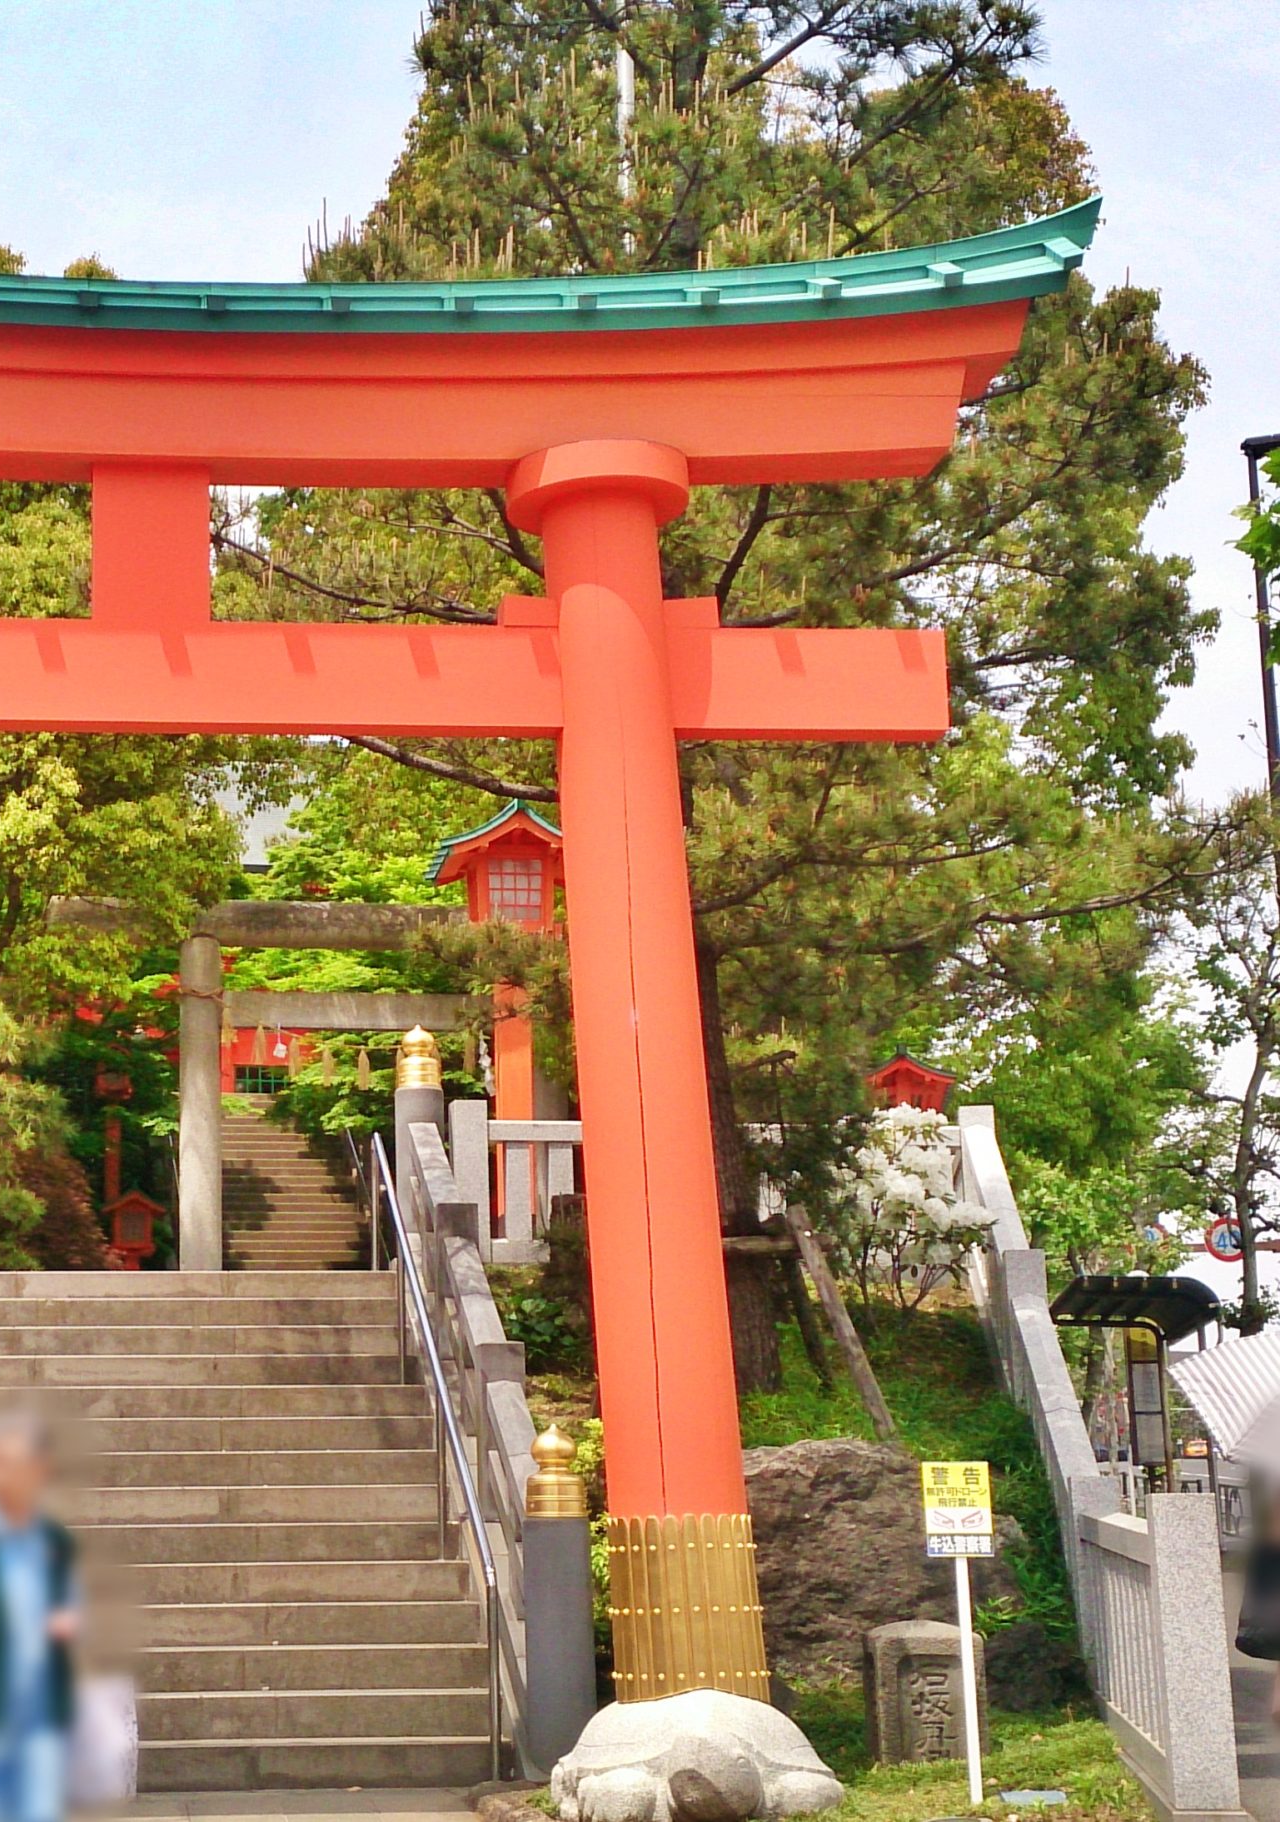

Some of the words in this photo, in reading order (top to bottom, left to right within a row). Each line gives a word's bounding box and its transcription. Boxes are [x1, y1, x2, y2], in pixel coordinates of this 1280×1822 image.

[931, 1466, 981, 1486] 警告
[926, 1486, 987, 1497] 無許可ドローン
[938, 1497, 978, 1508] 飛行禁止
